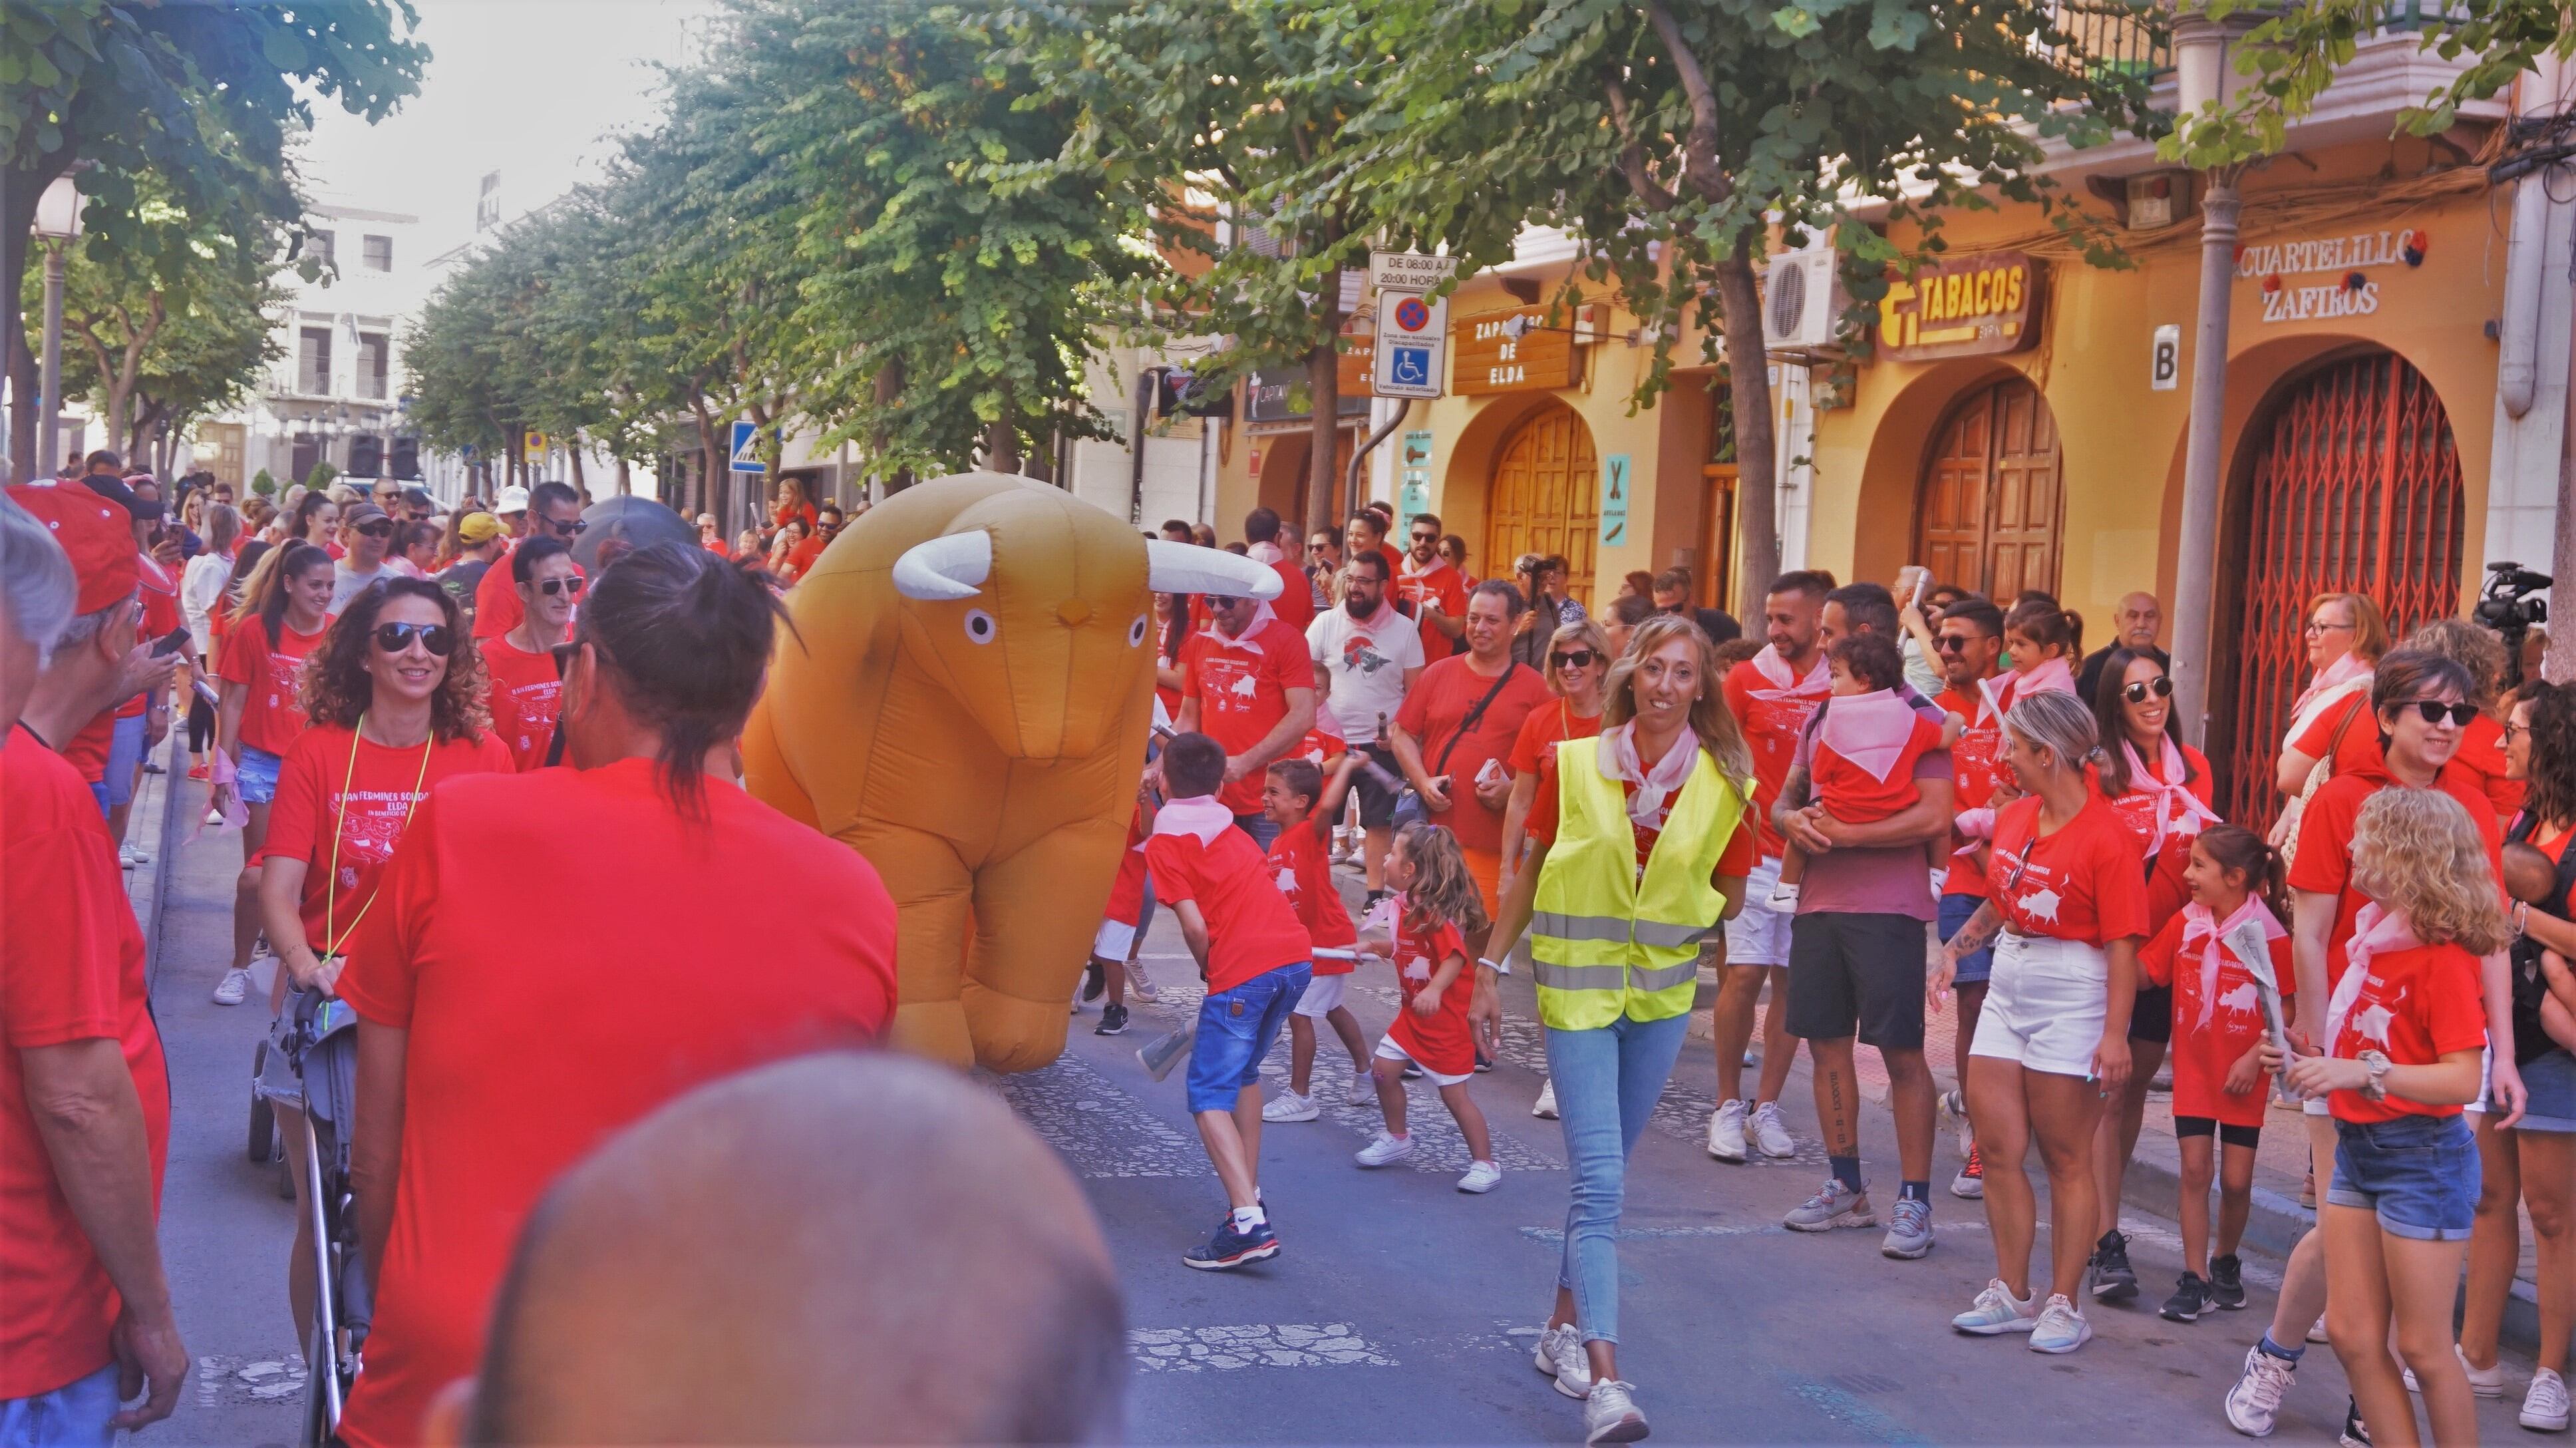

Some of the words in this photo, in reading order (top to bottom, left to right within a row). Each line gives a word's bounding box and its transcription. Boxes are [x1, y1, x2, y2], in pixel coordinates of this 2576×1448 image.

[1388, 257, 1404, 268] DE
[1406, 259, 1433, 270] 08:00
[1436, 260, 1443, 270] A
[1380, 273, 1407, 284] 20:00
[1410, 274, 1441, 286] HORA
[1921, 266, 2023, 321] TABACOS
[2263, 281, 2379, 322] ZAFIROS
[1500, 343, 1518, 360] DE
[2156, 342, 2175, 381] B
[1490, 365, 1525, 385] ELDA
[359, 791, 398, 802] FERMINES
[387, 801, 408, 811] ELDA
